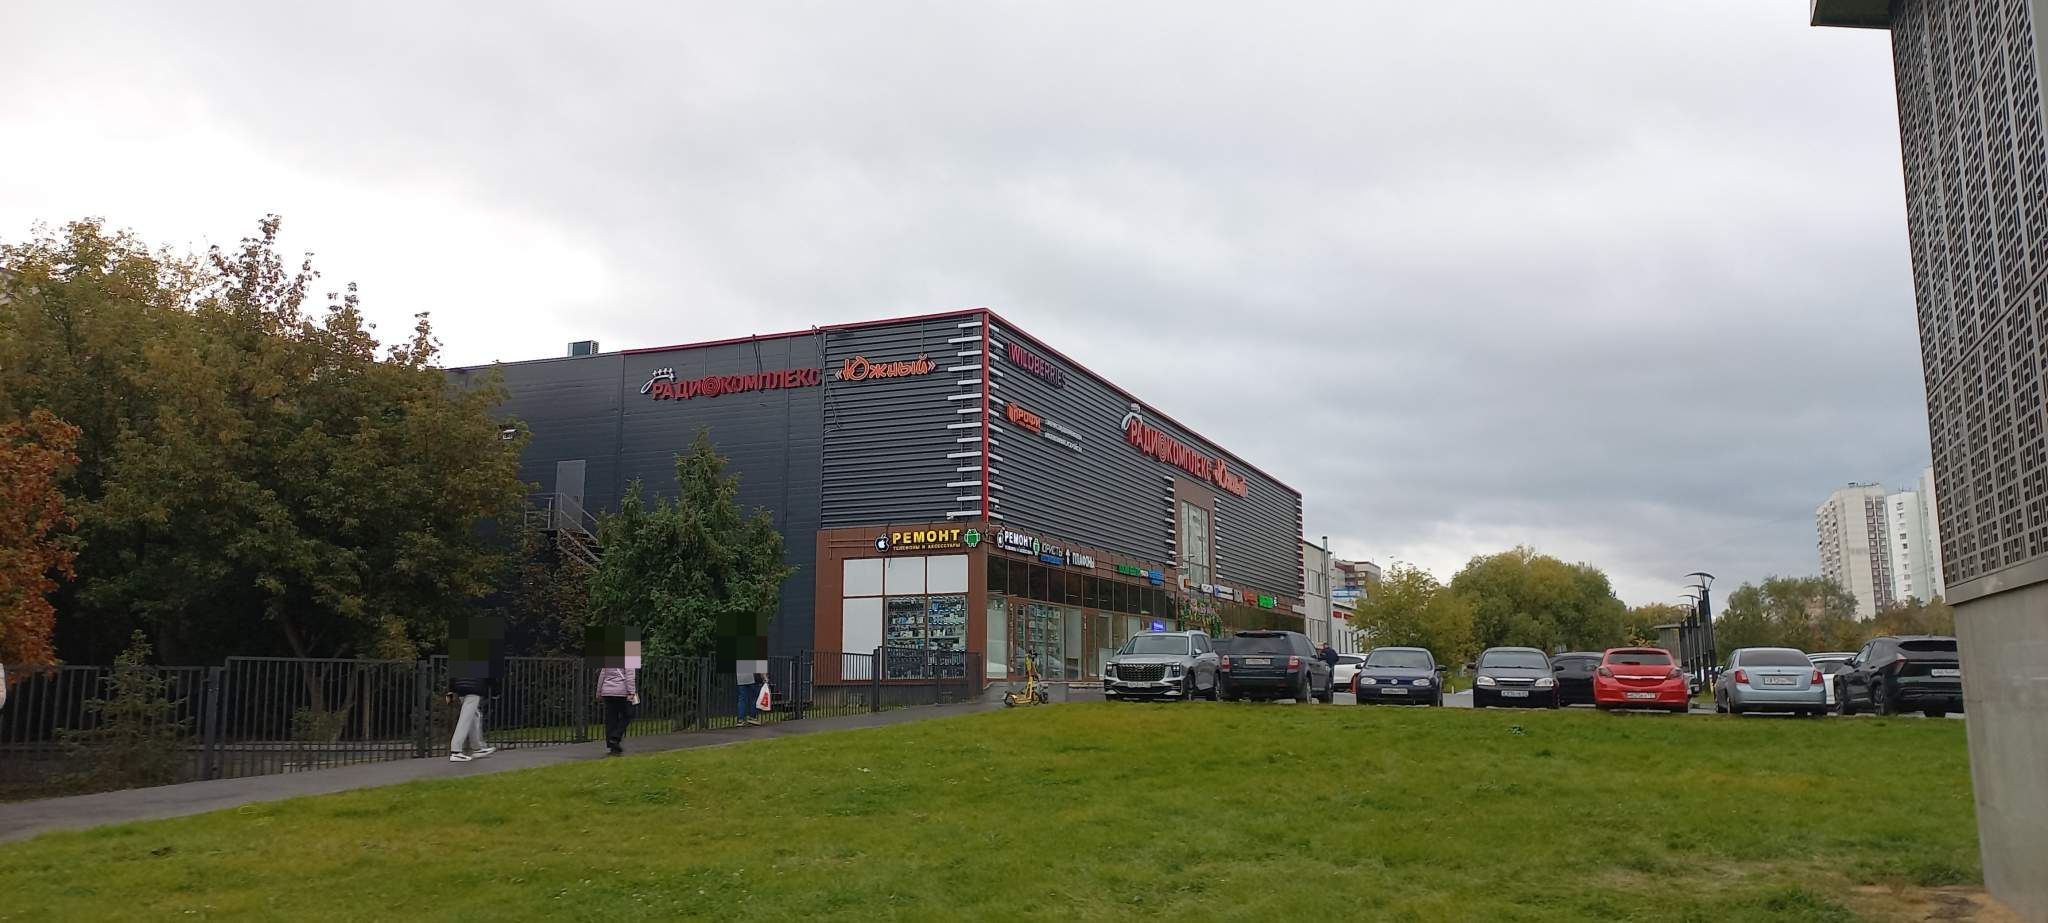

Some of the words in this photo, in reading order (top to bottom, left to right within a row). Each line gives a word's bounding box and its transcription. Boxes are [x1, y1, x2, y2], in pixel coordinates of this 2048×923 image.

[1007, 341, 1066, 388] WILDBERRIES
[892, 529, 961, 545] РЕМОНТ
[1004, 530, 1033, 548] РЕМОНТ
